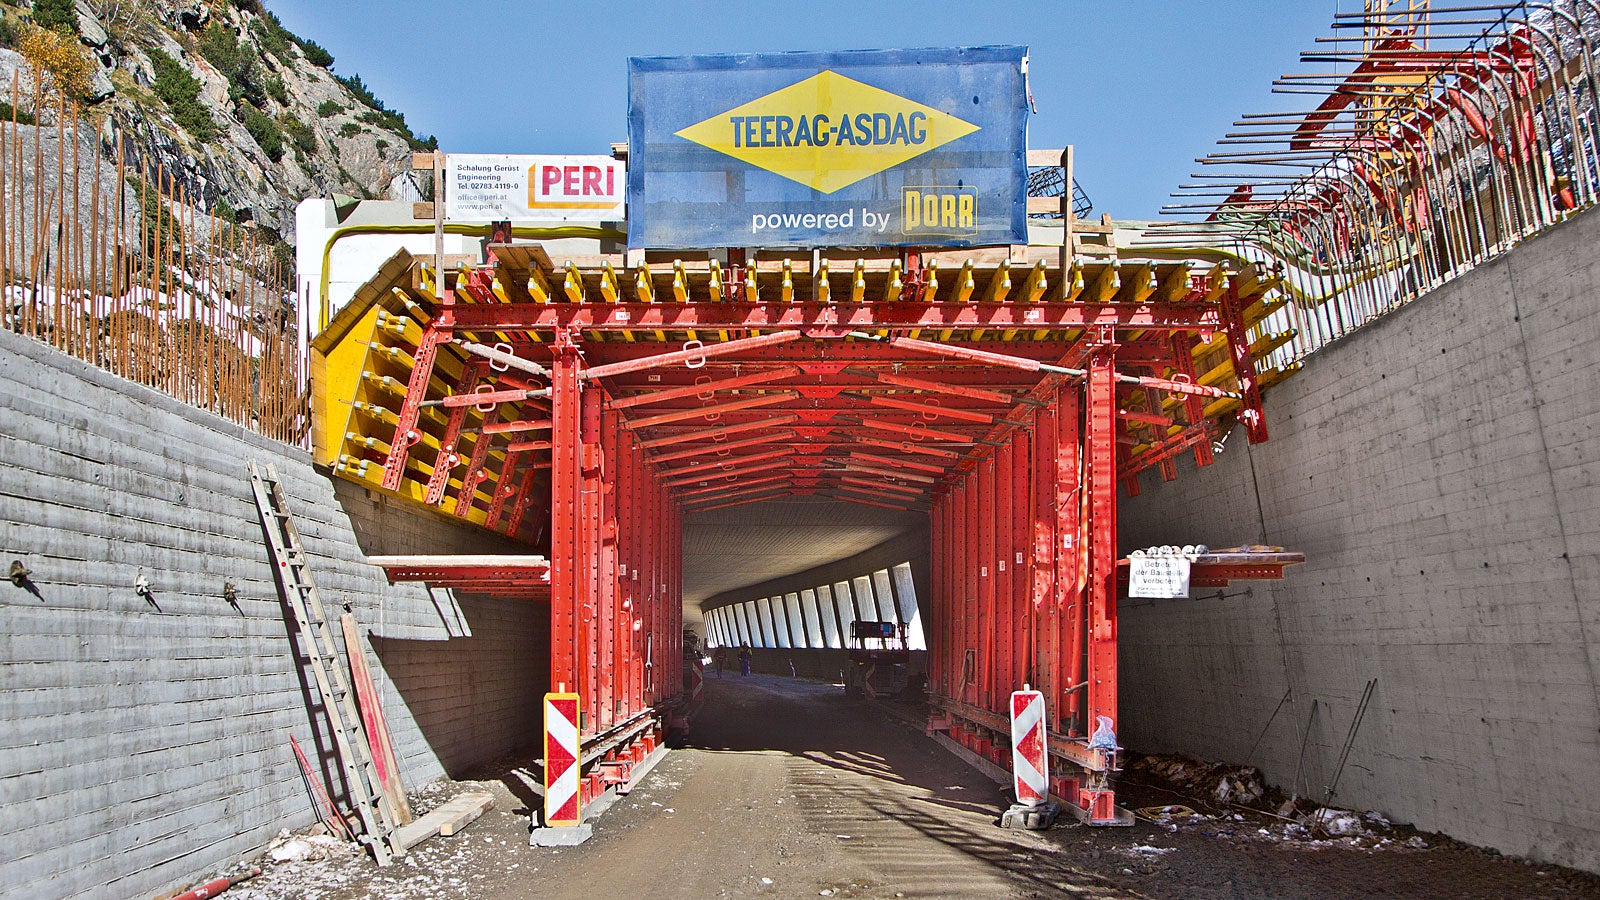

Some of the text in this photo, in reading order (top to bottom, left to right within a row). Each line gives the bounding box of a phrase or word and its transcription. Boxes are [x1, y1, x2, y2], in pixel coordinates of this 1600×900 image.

[729, 111, 927, 148] TEERAG-ASDAG
[457, 164, 519, 172] Schalung Gerüst
[457, 173, 501, 181] Engineering
[542, 165, 614, 196] PERI
[458, 182, 519, 190] Tel. 02783.4119-0
[457, 194, 507, 202] office@peri.at
[457, 203, 502, 211] www.peri.at
[905, 190, 974, 231] PORR
[752, 207, 891, 234] powered by
